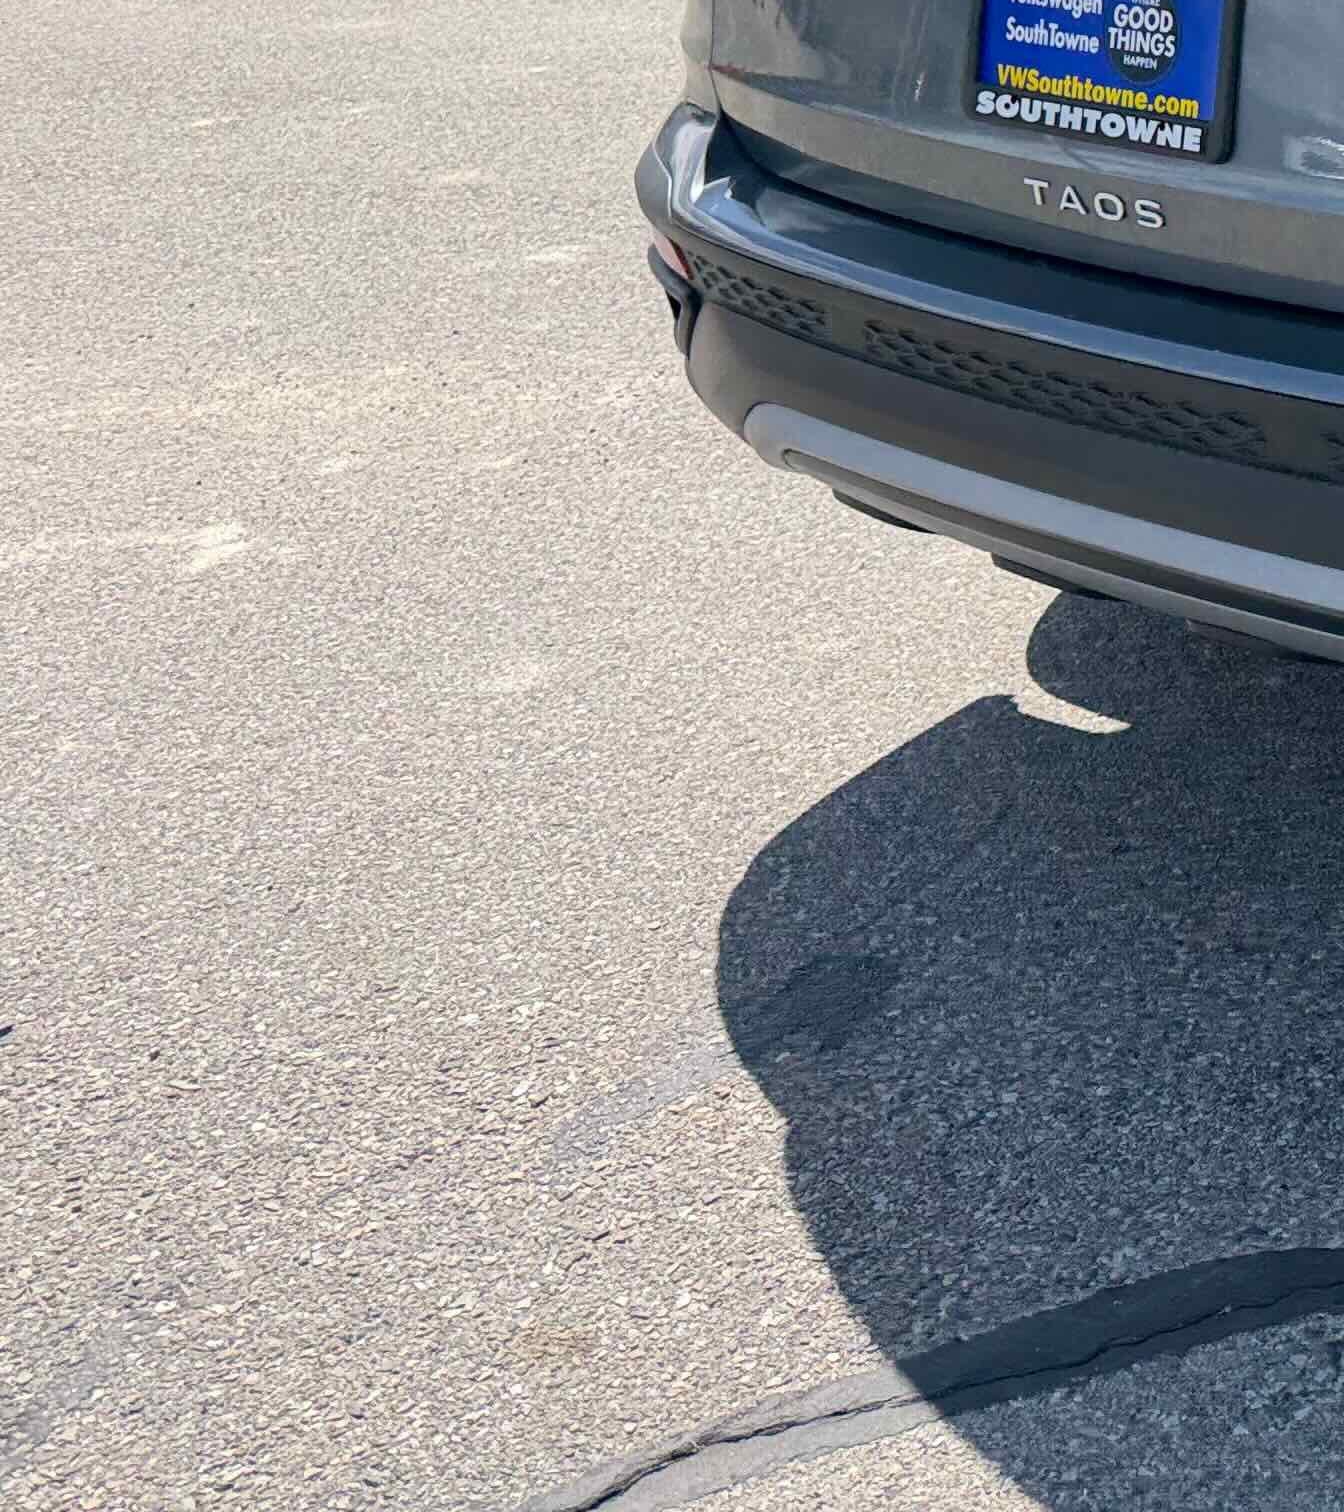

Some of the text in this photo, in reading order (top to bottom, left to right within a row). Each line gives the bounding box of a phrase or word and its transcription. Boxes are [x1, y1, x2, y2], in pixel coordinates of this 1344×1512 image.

[1005, 15, 1100, 54] SouthTowne
[1113, 3, 1174, 33] GOOD
[1107, 27, 1176, 58] THINGS
[1123, 54, 1158, 71] HAPPEN
[996, 63, 1200, 119] VWSouthtowne.com
[975, 90, 1203, 153] SOUTHTOWNE
[1023, 176, 1166, 229] TAOS
